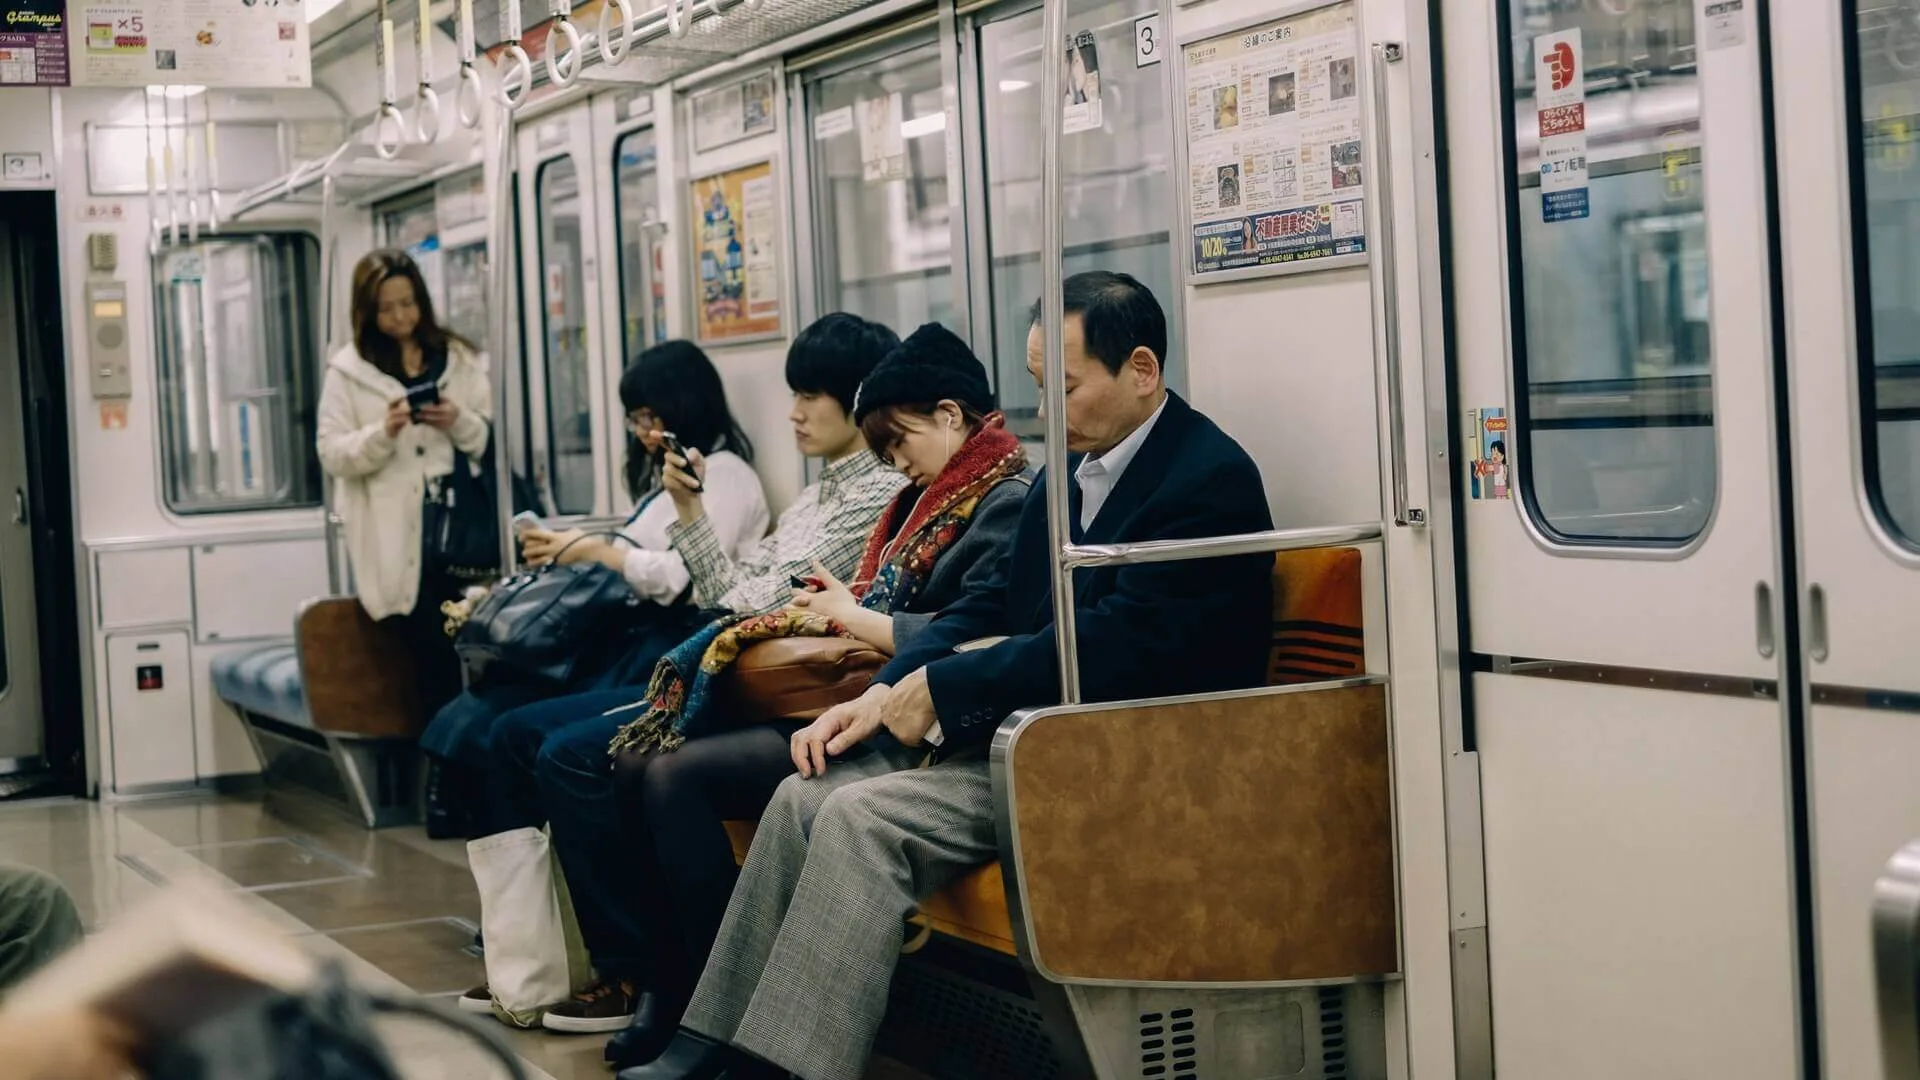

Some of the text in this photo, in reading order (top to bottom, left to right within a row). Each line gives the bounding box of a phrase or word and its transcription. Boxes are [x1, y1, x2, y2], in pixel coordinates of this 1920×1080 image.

[7, 11, 62, 25] Grampus
[1141, 26, 1154, 56] 3
[1244, 26, 1292, 49] 沿線のご案内
